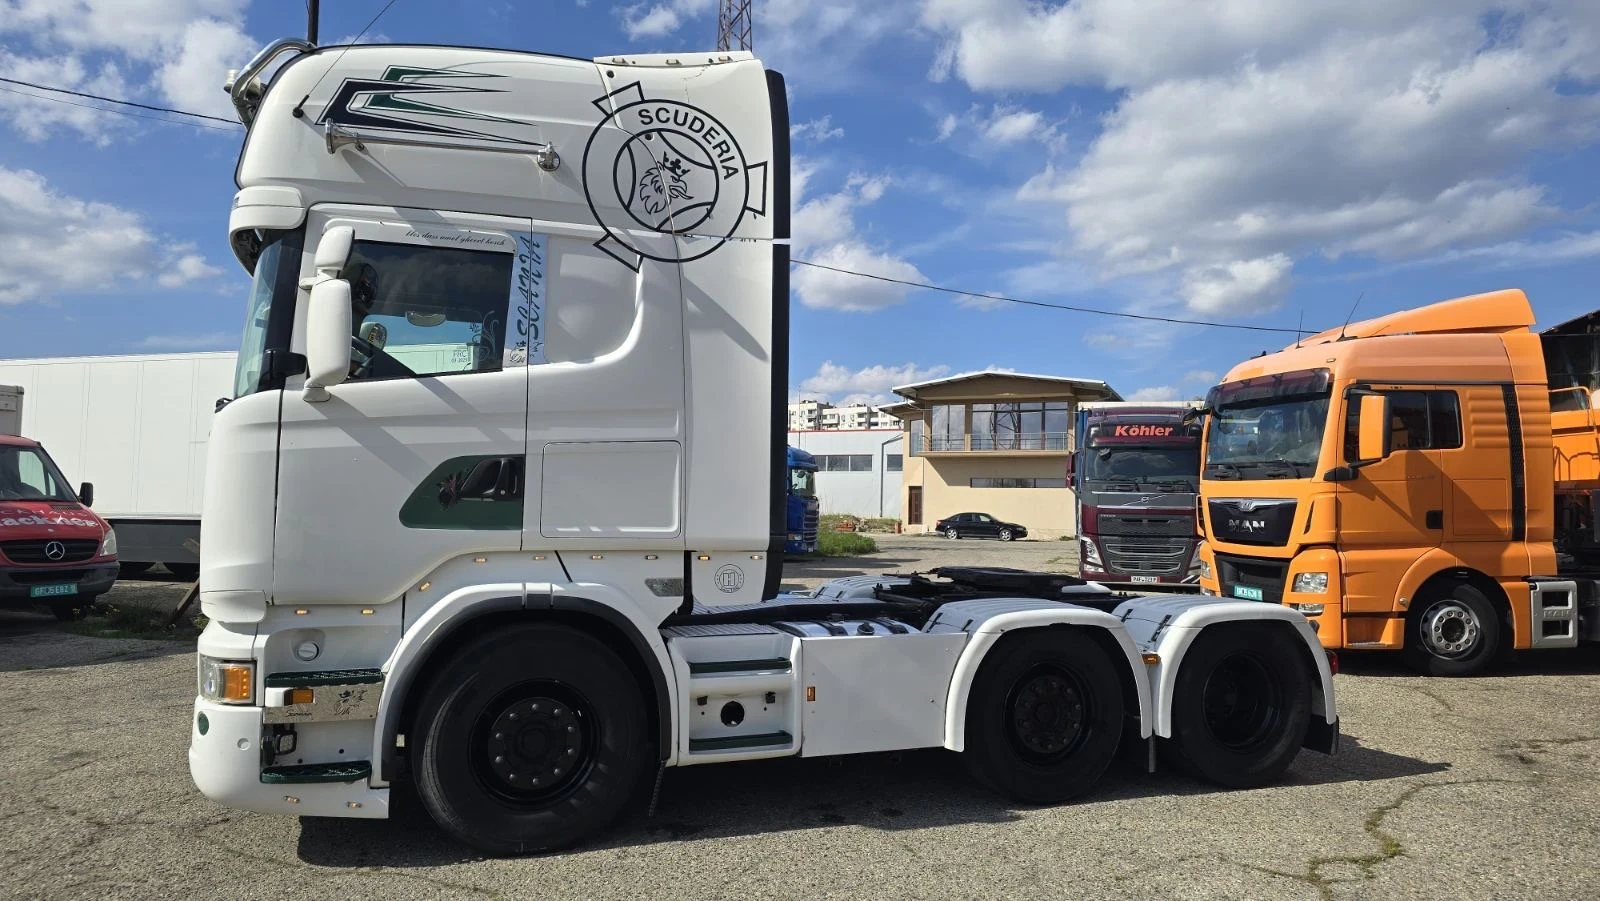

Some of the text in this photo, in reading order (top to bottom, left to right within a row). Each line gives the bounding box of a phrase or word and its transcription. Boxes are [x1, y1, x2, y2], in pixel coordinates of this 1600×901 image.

[638, 108, 738, 180] SCUDERIA
[1114, 424, 1174, 437] Köhler
[1228, 519, 1265, 533] MAN
